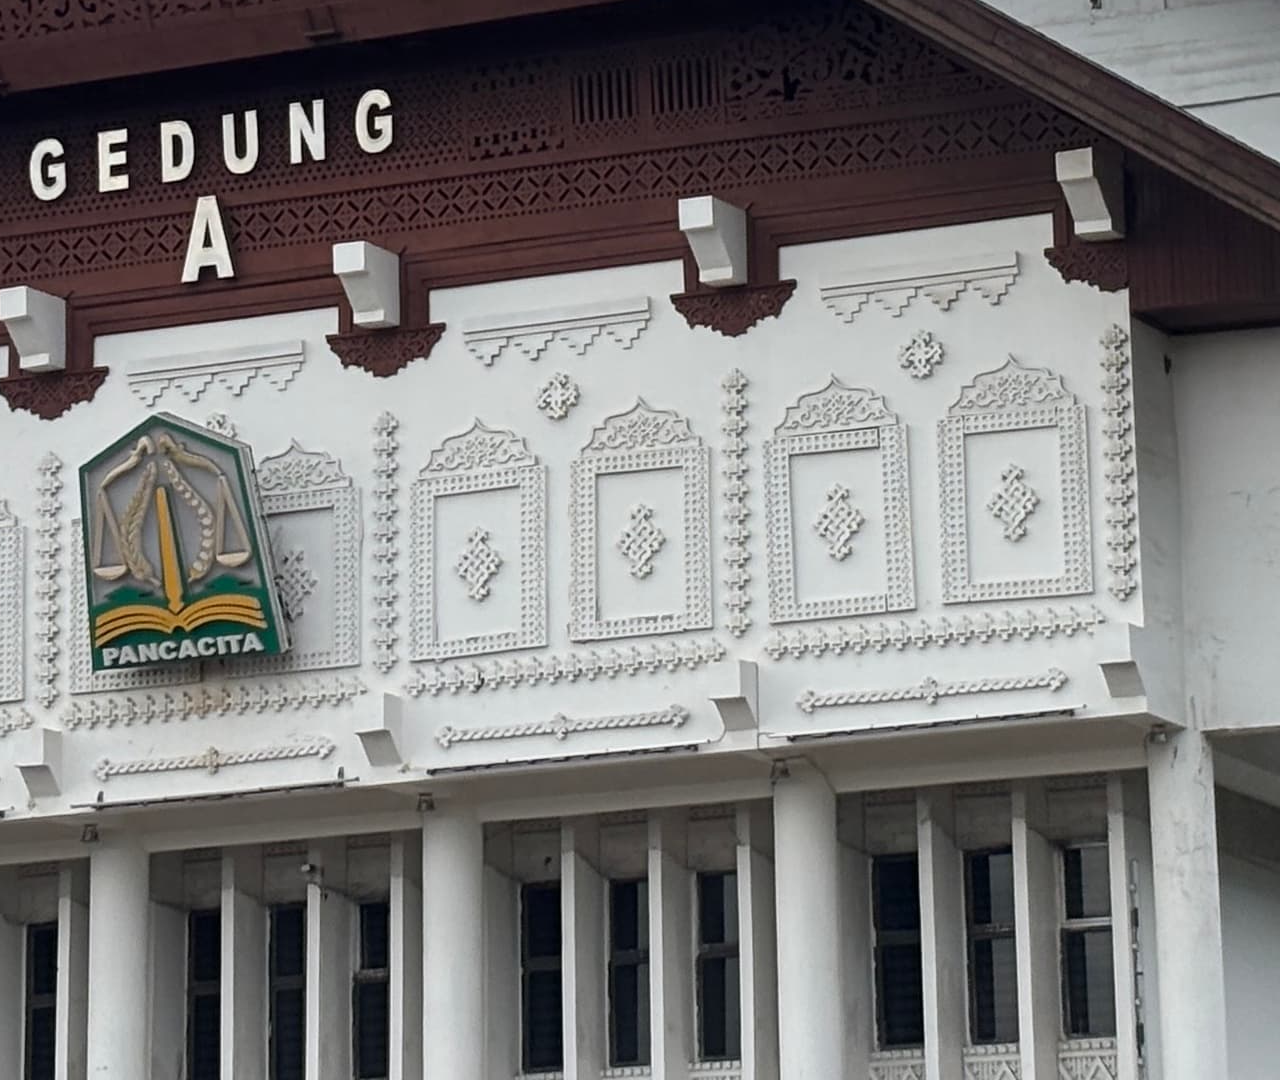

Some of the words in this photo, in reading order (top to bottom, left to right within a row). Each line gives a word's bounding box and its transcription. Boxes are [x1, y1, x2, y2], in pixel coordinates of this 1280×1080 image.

[29, 88, 394, 201] GEDUNG
[181, 195, 235, 283] A
[102, 632, 264, 666] PANCACITA
